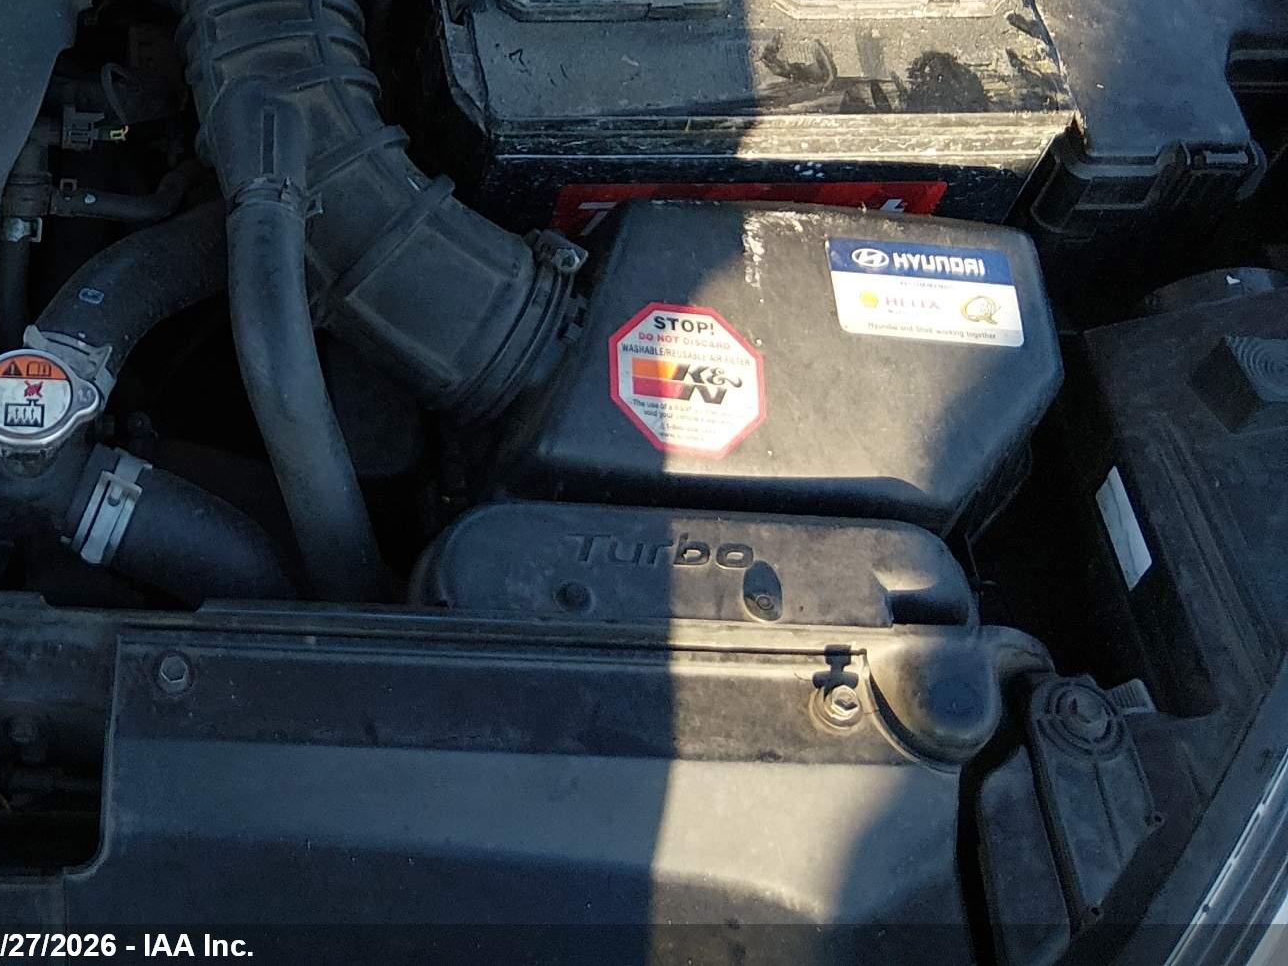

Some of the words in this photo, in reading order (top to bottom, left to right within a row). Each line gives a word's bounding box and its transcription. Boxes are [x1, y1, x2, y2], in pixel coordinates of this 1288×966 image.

[893, 252, 986, 276] HYUNDAI
[654, 316, 715, 335] STOP!
[936, 328, 965, 338] working
[966, 331, 997, 340] together
[638, 332, 654, 341] DO
[657, 335, 679, 344] NOT
[683, 337, 731, 350] DISCARD
[632, 399, 646, 407] The
[567, 532, 754, 569] Turbo
